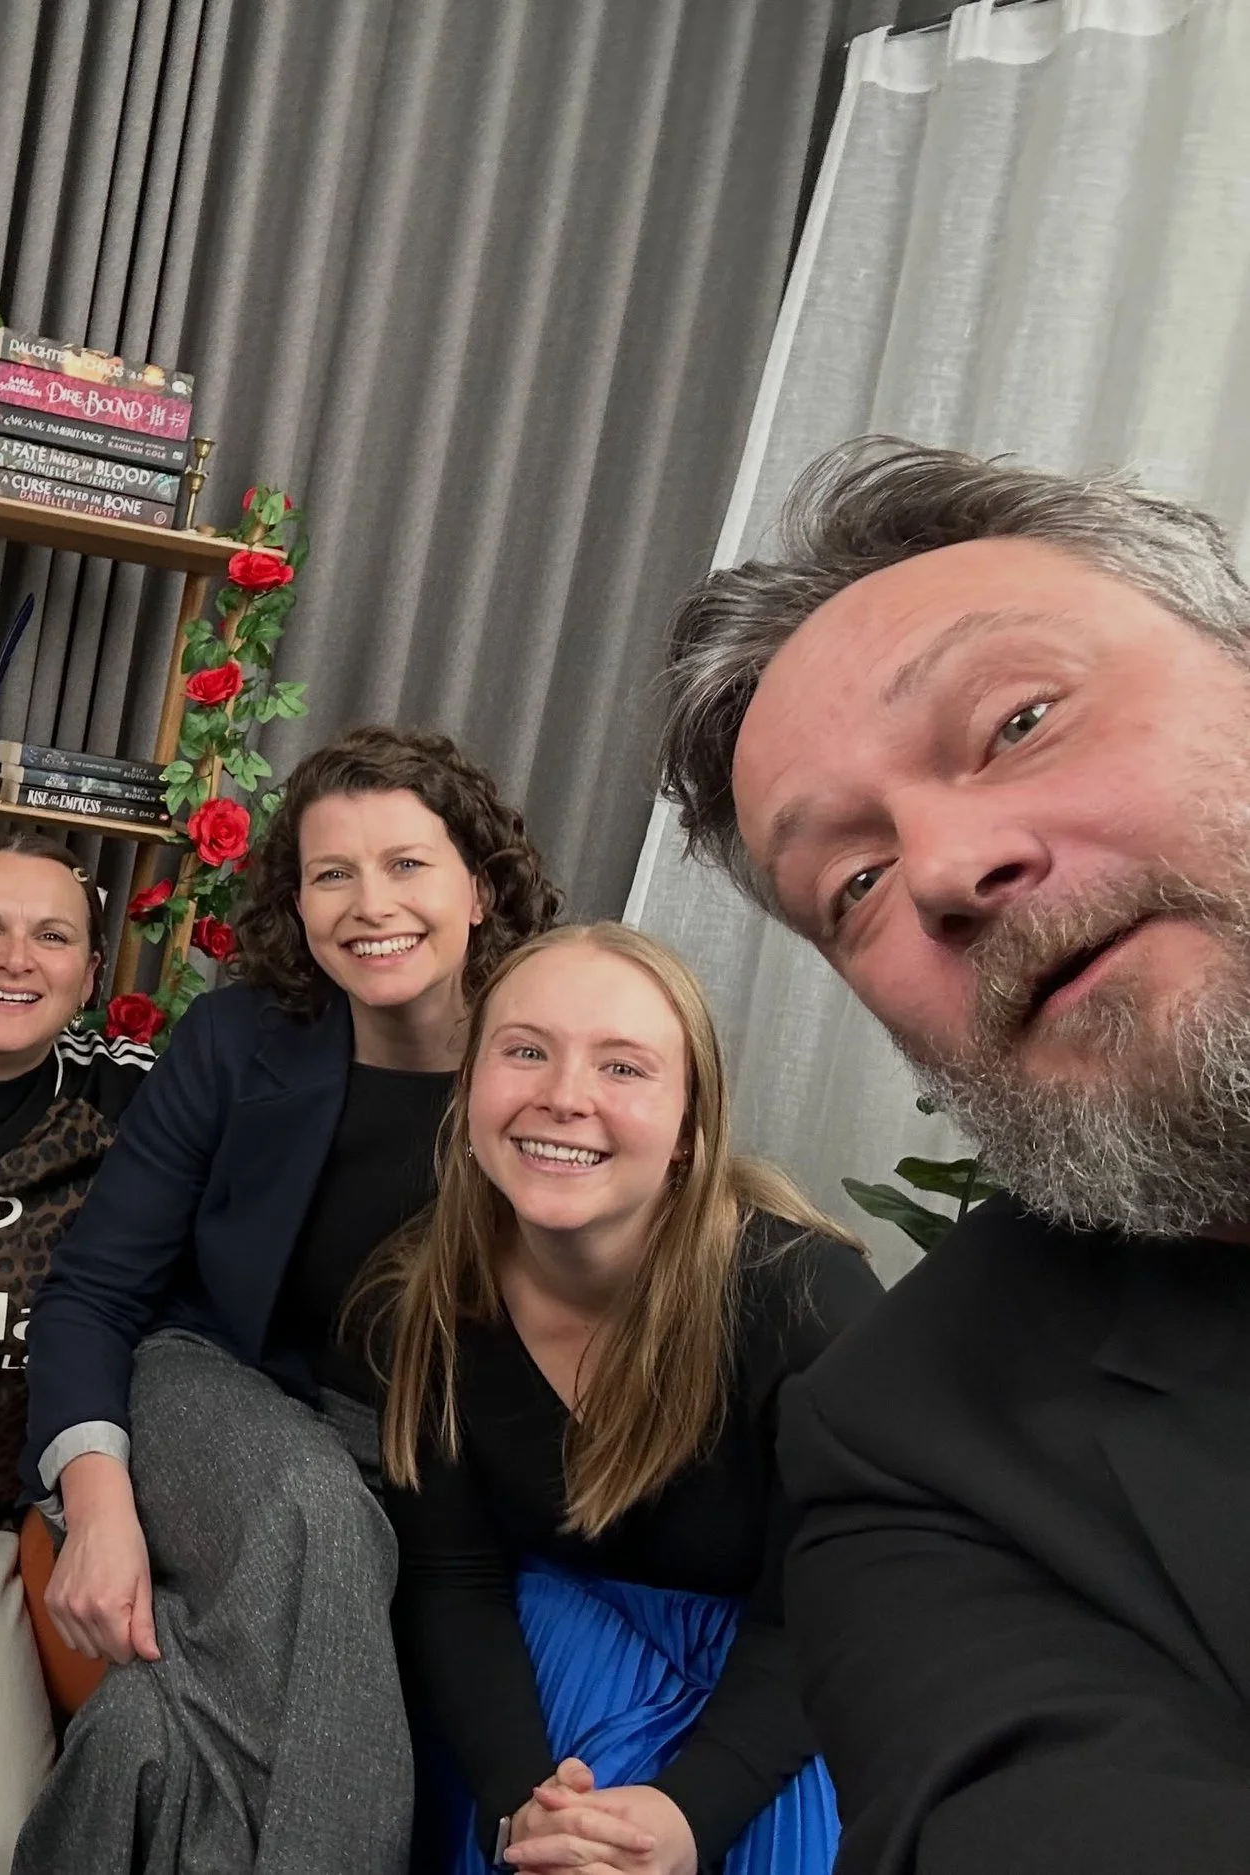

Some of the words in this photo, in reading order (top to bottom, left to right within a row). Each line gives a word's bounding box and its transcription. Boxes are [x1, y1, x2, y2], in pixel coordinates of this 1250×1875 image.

[0, 382, 42, 398] SORENSEN
[46, 382, 85, 407] DIRE
[82, 389, 142, 421] BOUND
[46, 423, 104, 444] INHERITANCE
[1, 443, 9, 453] A
[10, 443, 47, 463] FATE
[49, 448, 79, 469] INKED
[82, 459, 93, 470] IN
[95, 460, 150, 485] BLOOD
[145, 448, 167, 460] COLE
[22, 461, 71, 480] DANIELLE
[87, 474, 125, 491] JENSEN
[1, 474, 8, 484] A
[12, 474, 51, 494] CURSE
[54, 487, 88, 501] CARVED
[91, 494, 102, 503] IN
[103, 493, 142, 515] BONE
[20, 491, 68, 509] DANIELLE
[84, 504, 121, 519] JENSEN
[123, 771, 155, 782] RIORDAN
[27, 789, 48, 807] RISE
[59, 796, 101, 814] EMPRESS
[104, 806, 126, 814] JULIE
[139, 810, 155, 819] DAO
[124, 792, 156, 803] RIORDAN
